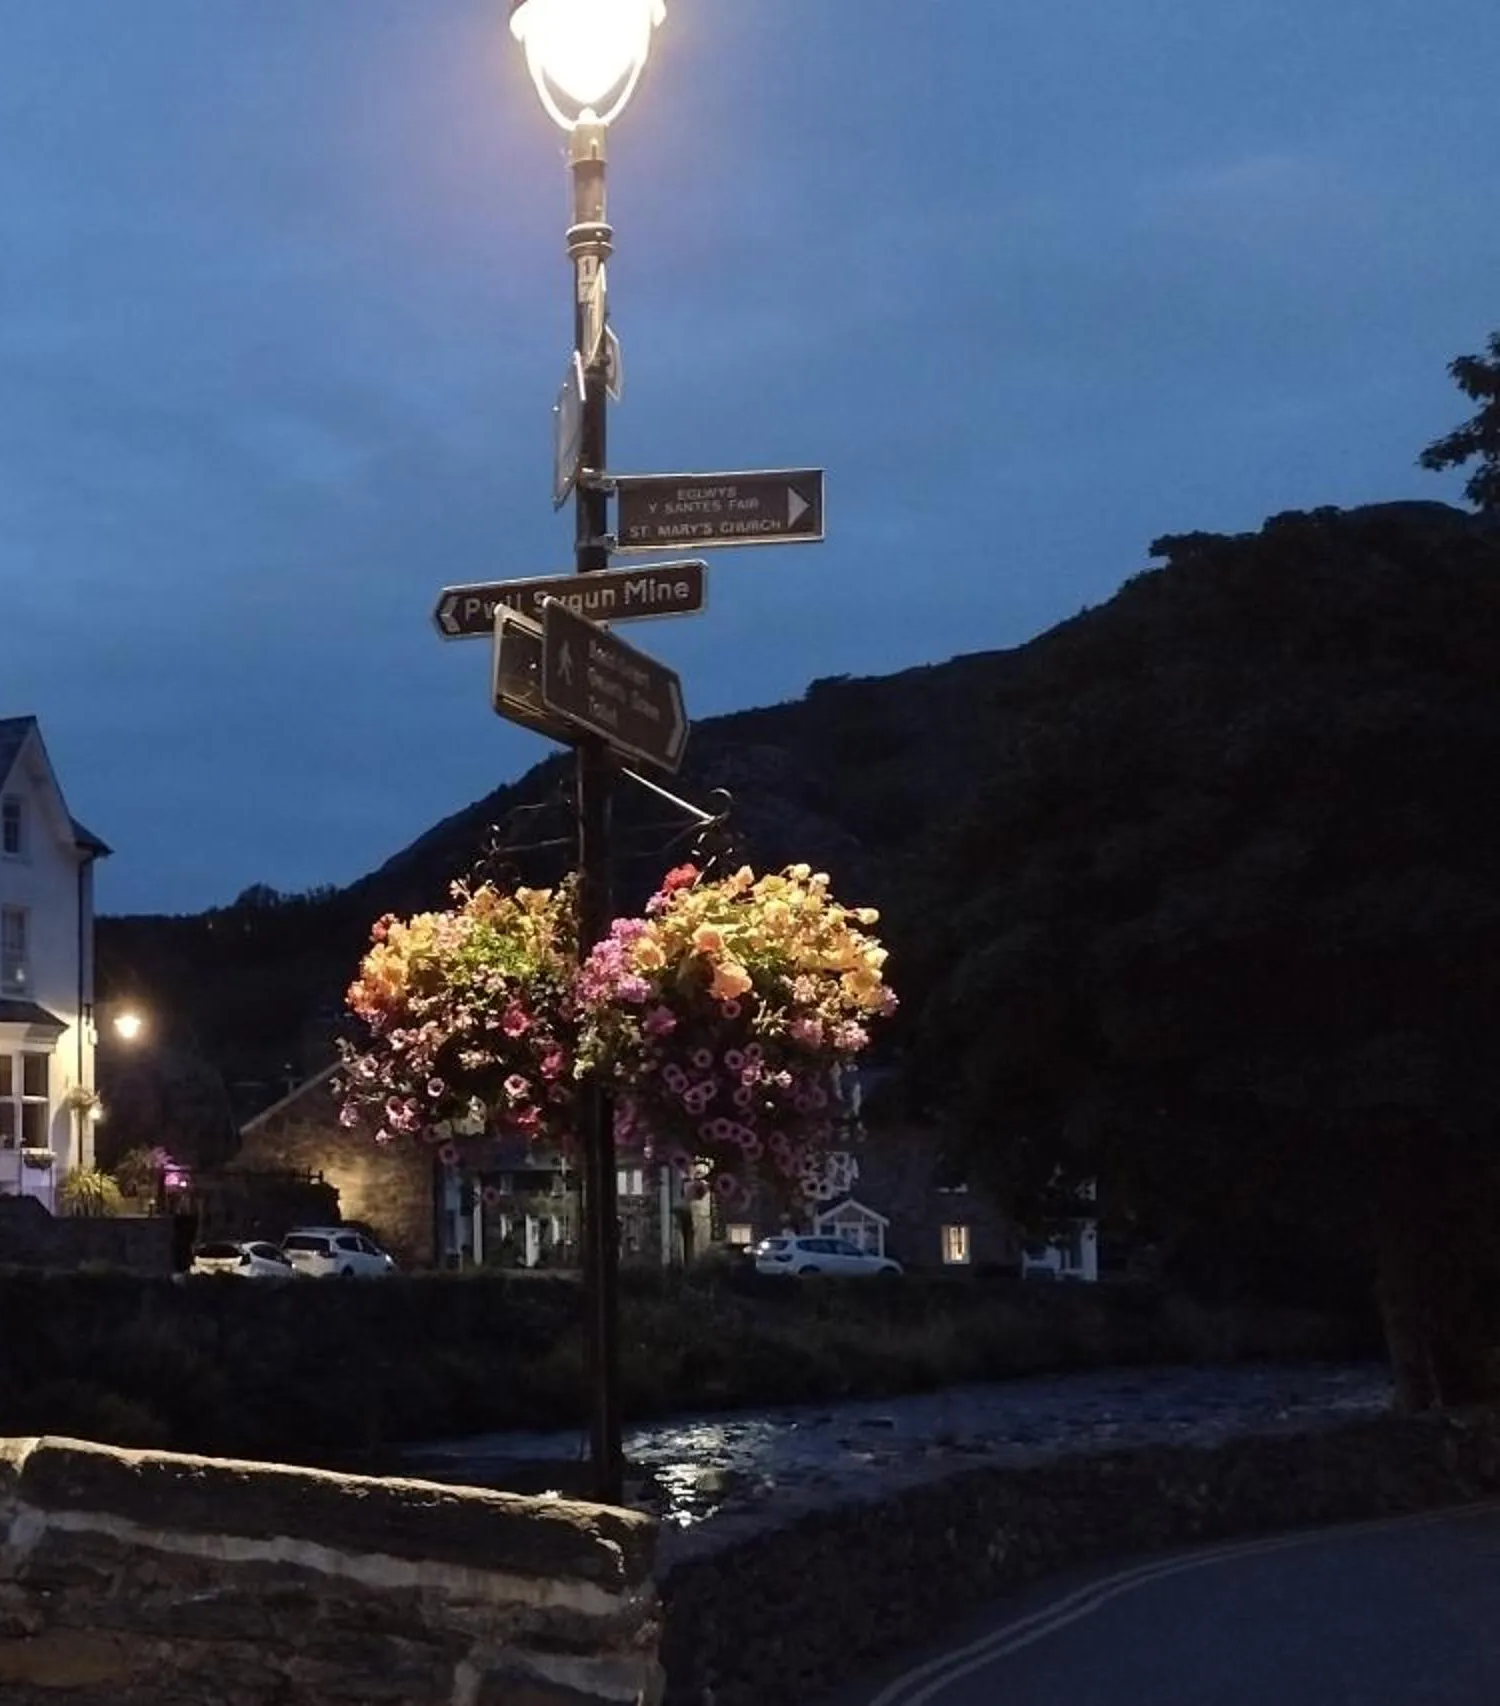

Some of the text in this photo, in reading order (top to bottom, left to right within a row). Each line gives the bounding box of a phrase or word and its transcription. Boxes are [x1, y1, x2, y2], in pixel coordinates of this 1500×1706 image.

[658, 522, 713, 538] MARY'S
[720, 519, 781, 534] CHURCH
[624, 578, 690, 605] Mine
